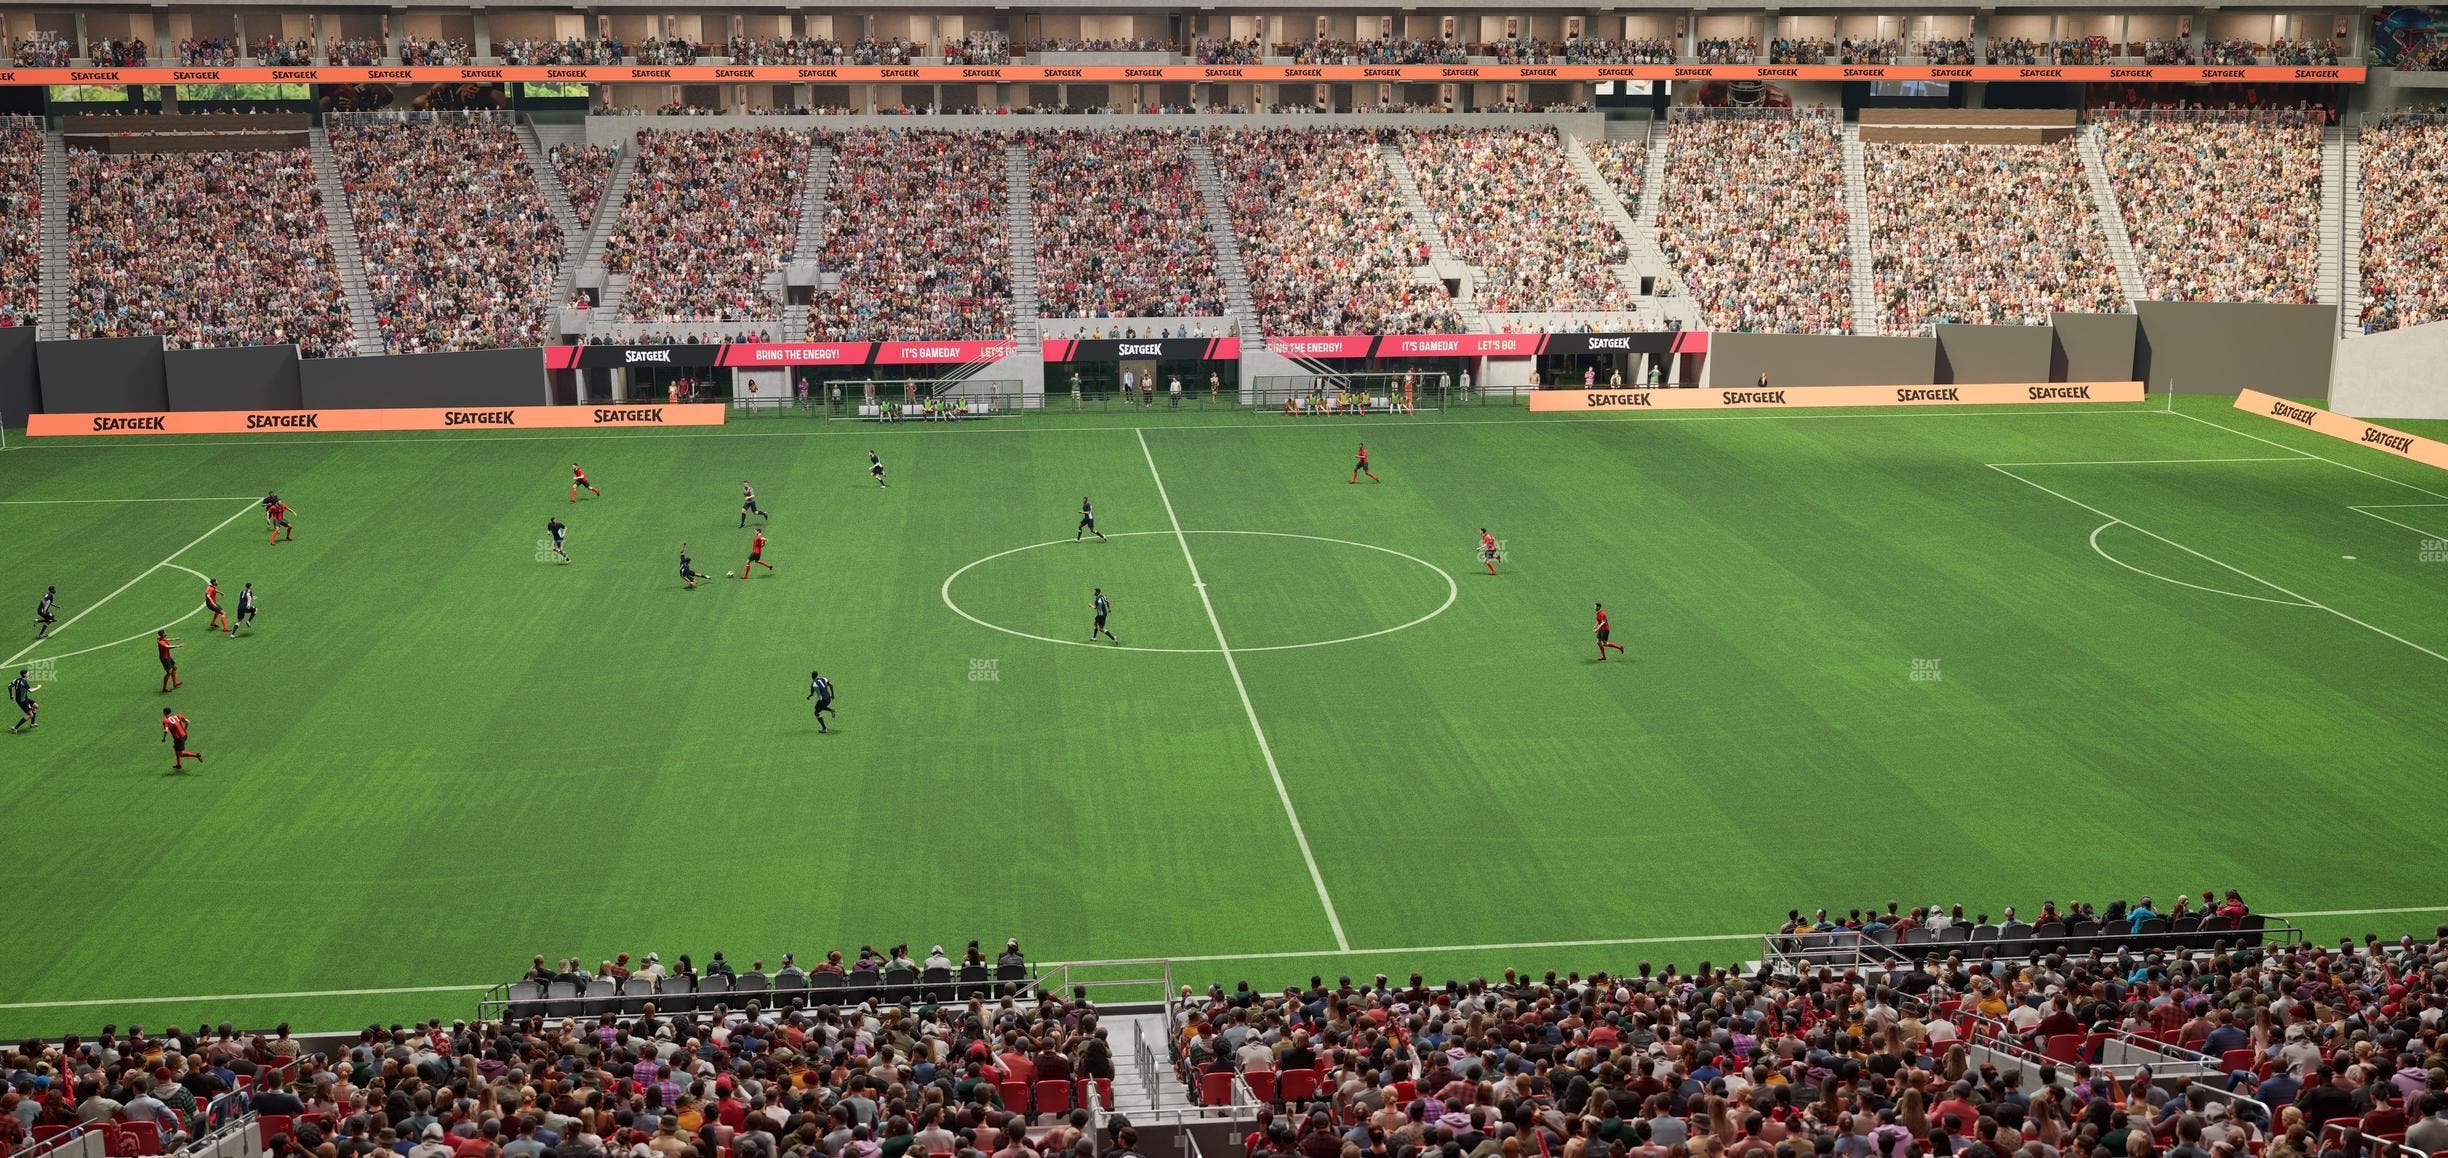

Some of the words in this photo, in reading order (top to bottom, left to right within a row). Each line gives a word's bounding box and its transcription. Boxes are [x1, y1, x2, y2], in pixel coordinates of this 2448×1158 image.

[71, 72, 119, 80] SEATGEEK
[173, 71, 220, 80] SEATGEEK
[272, 71, 317, 79] SEATGEEK
[368, 70, 412, 79] SEATGEEK
[461, 70, 502, 78] SEATGEEK
[547, 70, 587, 78] SEATGEEK
[632, 70, 671, 78] SEATGEEK
[963, 69, 1001, 77] SEATGEEK
[1044, 69, 1081, 77] SEATGEEK
[1125, 69, 1162, 77] SEATGEEK
[1205, 69, 1242, 77] SEATGEEK
[1931, 69, 1972, 77] SEATGEEK
[2020, 69, 2062, 77] SEATGEEK
[2110, 69, 2153, 78] SEATGEEK
[2202, 70, 2245, 78] SEATGEEK
[2295, 70, 2339, 78] SEATGEEK
[1307, 342, 1343, 352] ENERGY!
[1402, 341, 1418, 351] IT'S
[1419, 341, 1459, 351] GAMEDAY
[1477, 340, 1501, 350] LET'S
[1502, 340, 1516, 350] GO!
[1588, 336, 1630, 350] SEATGEEK
[901, 347, 918, 358] IT'S
[919, 347, 960, 358] GAMEDAY
[1119, 343, 1162, 356] SEATGEEK
[626, 350, 670, 363] SEATGEEK
[756, 350, 783, 361] BRING
[785, 350, 802, 360] THE
[803, 349, 840, 360] ENERGY!
[1723, 390, 1786, 405] SEATGEEK
[1897, 388, 1959, 402] SEATGEEK
[2028, 386, 2090, 400] SEATGEEK
[1587, 392, 1651, 407] SEATGEEK
[444, 410, 515, 426] SEATGEEK
[594, 408, 663, 423] SEATGEEK
[2270, 401, 2317, 426] SEATGEEK
[93, 416, 165, 432] SEATGEEK
[247, 413, 318, 429] SEATGEEK
[2361, 427, 2414, 454] SEATGEEK
